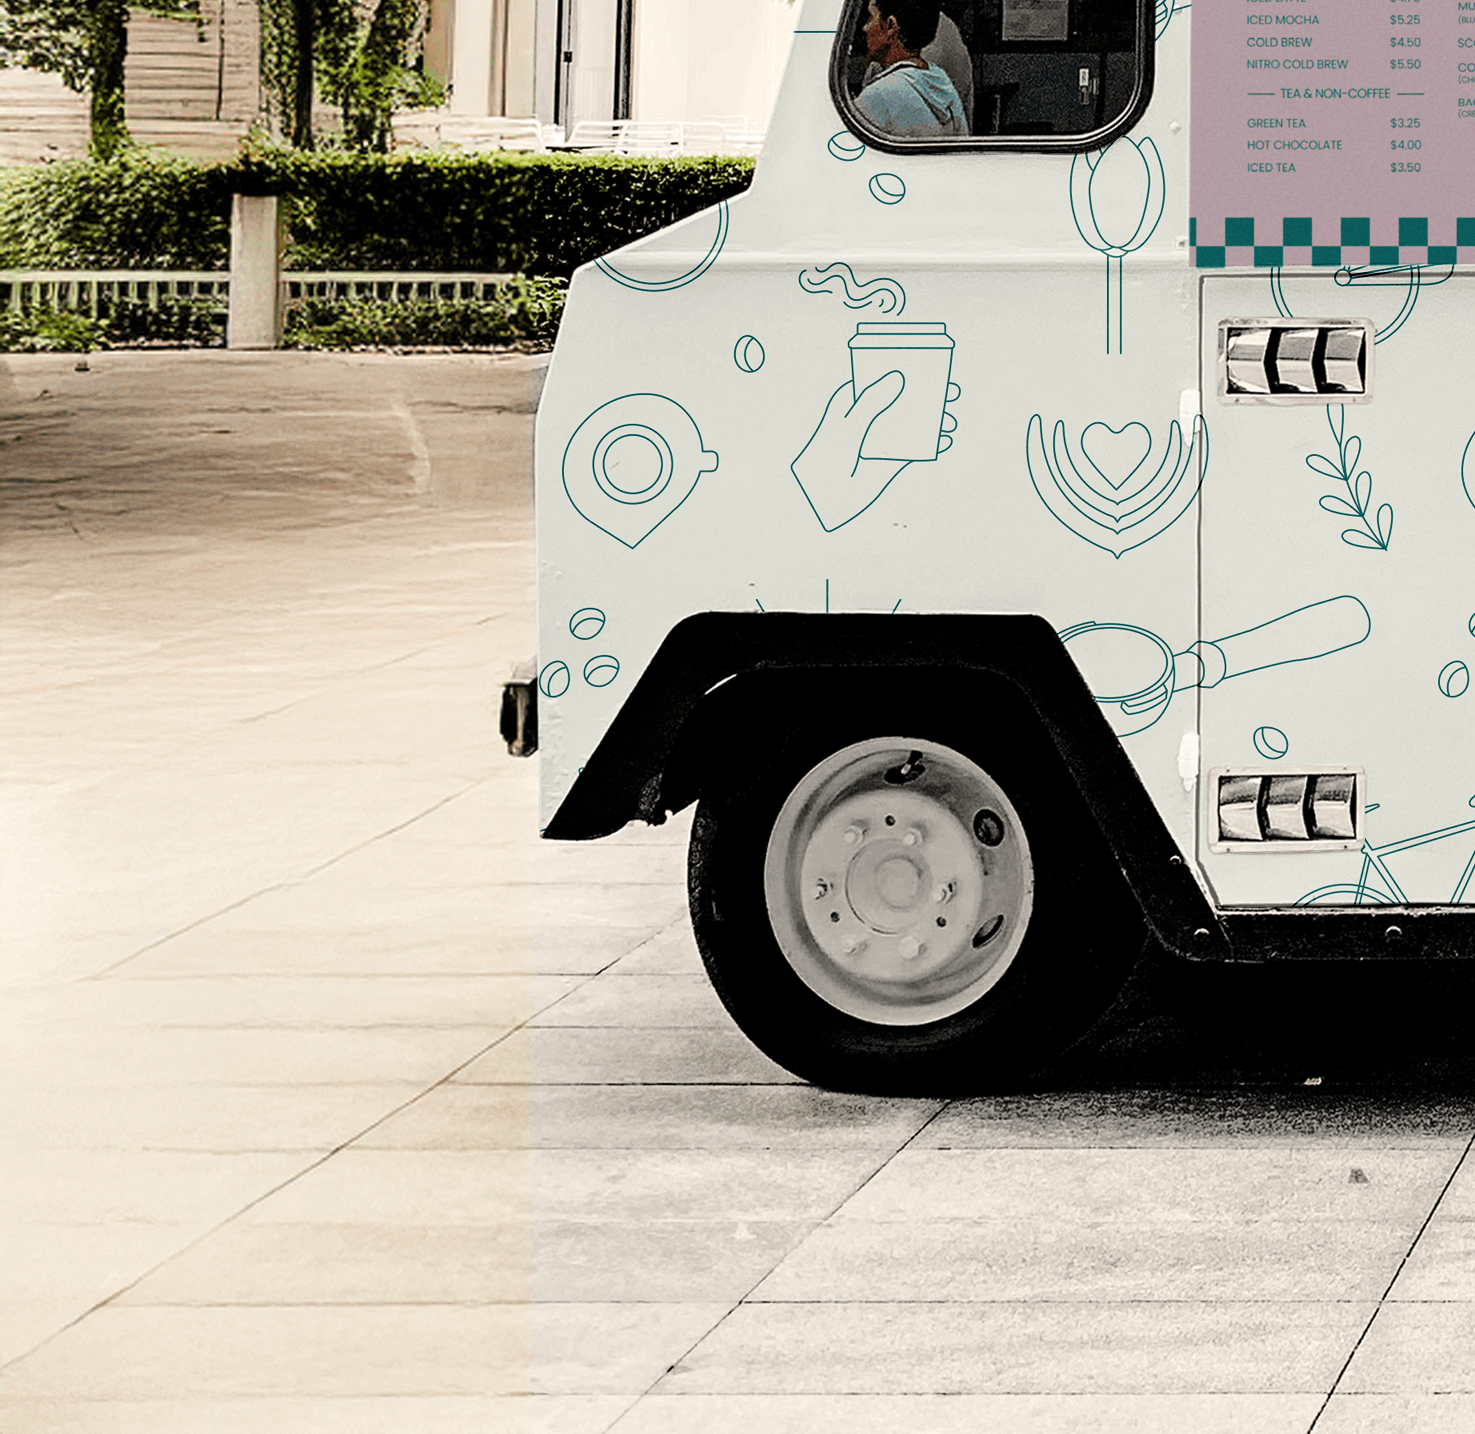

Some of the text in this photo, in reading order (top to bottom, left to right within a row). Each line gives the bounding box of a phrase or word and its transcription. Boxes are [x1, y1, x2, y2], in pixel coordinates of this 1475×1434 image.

[1246, 14, 1421, 26] ICED MOCHA $5.25
[1246, 36, 1422, 48] COLD BREW $4.50
[1246, 58, 1422, 70] NITRO COLD BREW $5.50
[1280, 87, 1391, 99] TEA & NON-COFFEE
[1246, 117, 1421, 129] GREEN TEA $3.25
[1246, 139, 1422, 151] HOT CHOCOLATE $4.00
[1247, 161, 1422, 174] ICED TEA $3.50
